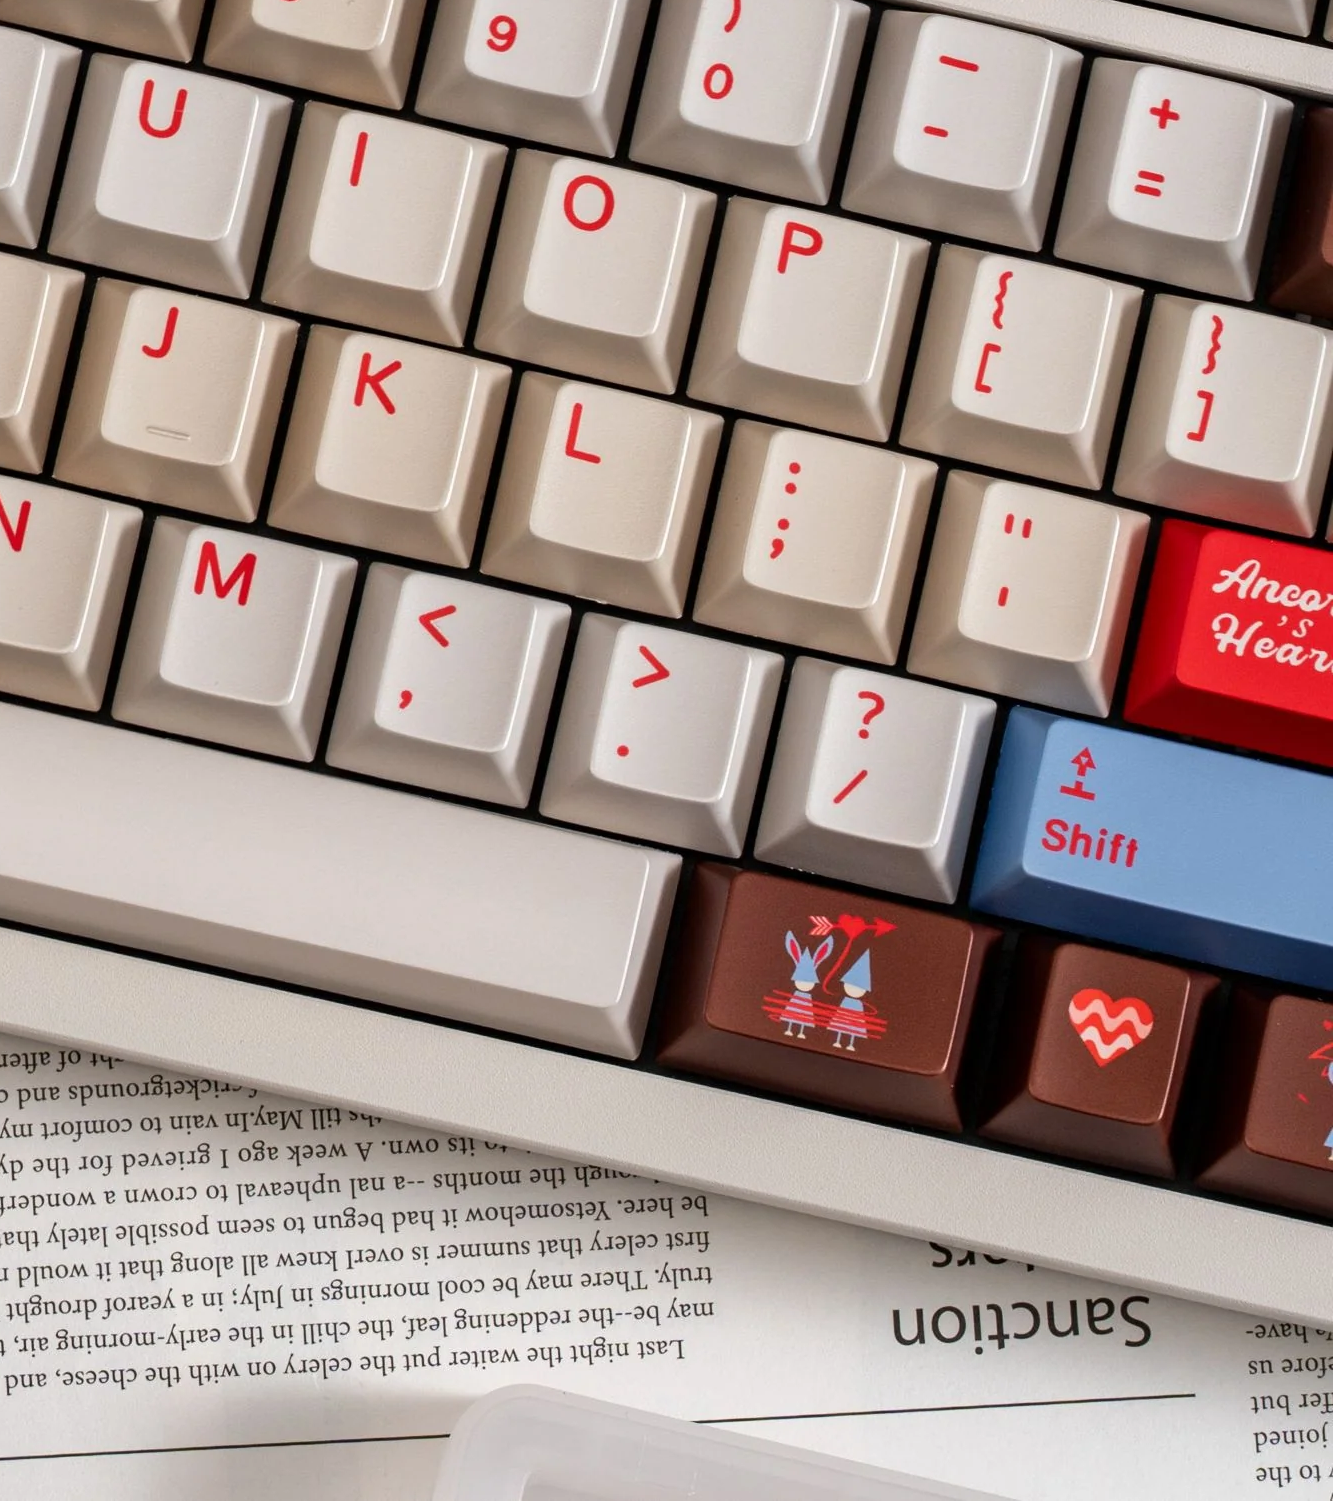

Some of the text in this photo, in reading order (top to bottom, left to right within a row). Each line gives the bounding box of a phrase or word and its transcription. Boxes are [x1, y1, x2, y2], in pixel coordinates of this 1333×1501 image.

[487, 15, 517, 52] 9
[703, 63, 734, 99] 0
[139, 79, 188, 139] U
[1150, 99, 1179, 129] +
[777, 221, 823, 274] P
[141, 307, 179, 359] J
[354, 352, 402, 415] K
[565, 403, 601, 464] L
[194, 541, 257, 606] M
[1211, 612, 1333, 674] Hear
[858, 691, 884, 739] ?
[1042, 819, 1137, 867] Shift
[892, 1295, 1151, 1355] Sanction
[403, 1346, 441, 1371] put
[449, 1348, 520, 1370] waiter
[527, 1346, 563, 1368] the
[570, 1337, 629, 1365] night
[637, 1340, 685, 1359] Last
[56, 1368, 137, 1390] cheese,
[145, 1366, 181, 1388] the
[188, 1363, 240, 1386] with
[247, 1361, 276, 1376] on
[283, 1353, 352, 1379] celery
[360, 1355, 396, 1377] the
[1247, 1359, 1273, 1376] us
[4, 1373, 47, 1396] and
[1250, 1394, 1291, 1416] but
[1252, 1421, 1328, 1454] joined
[1255, 1465, 1321, 1488] to the
